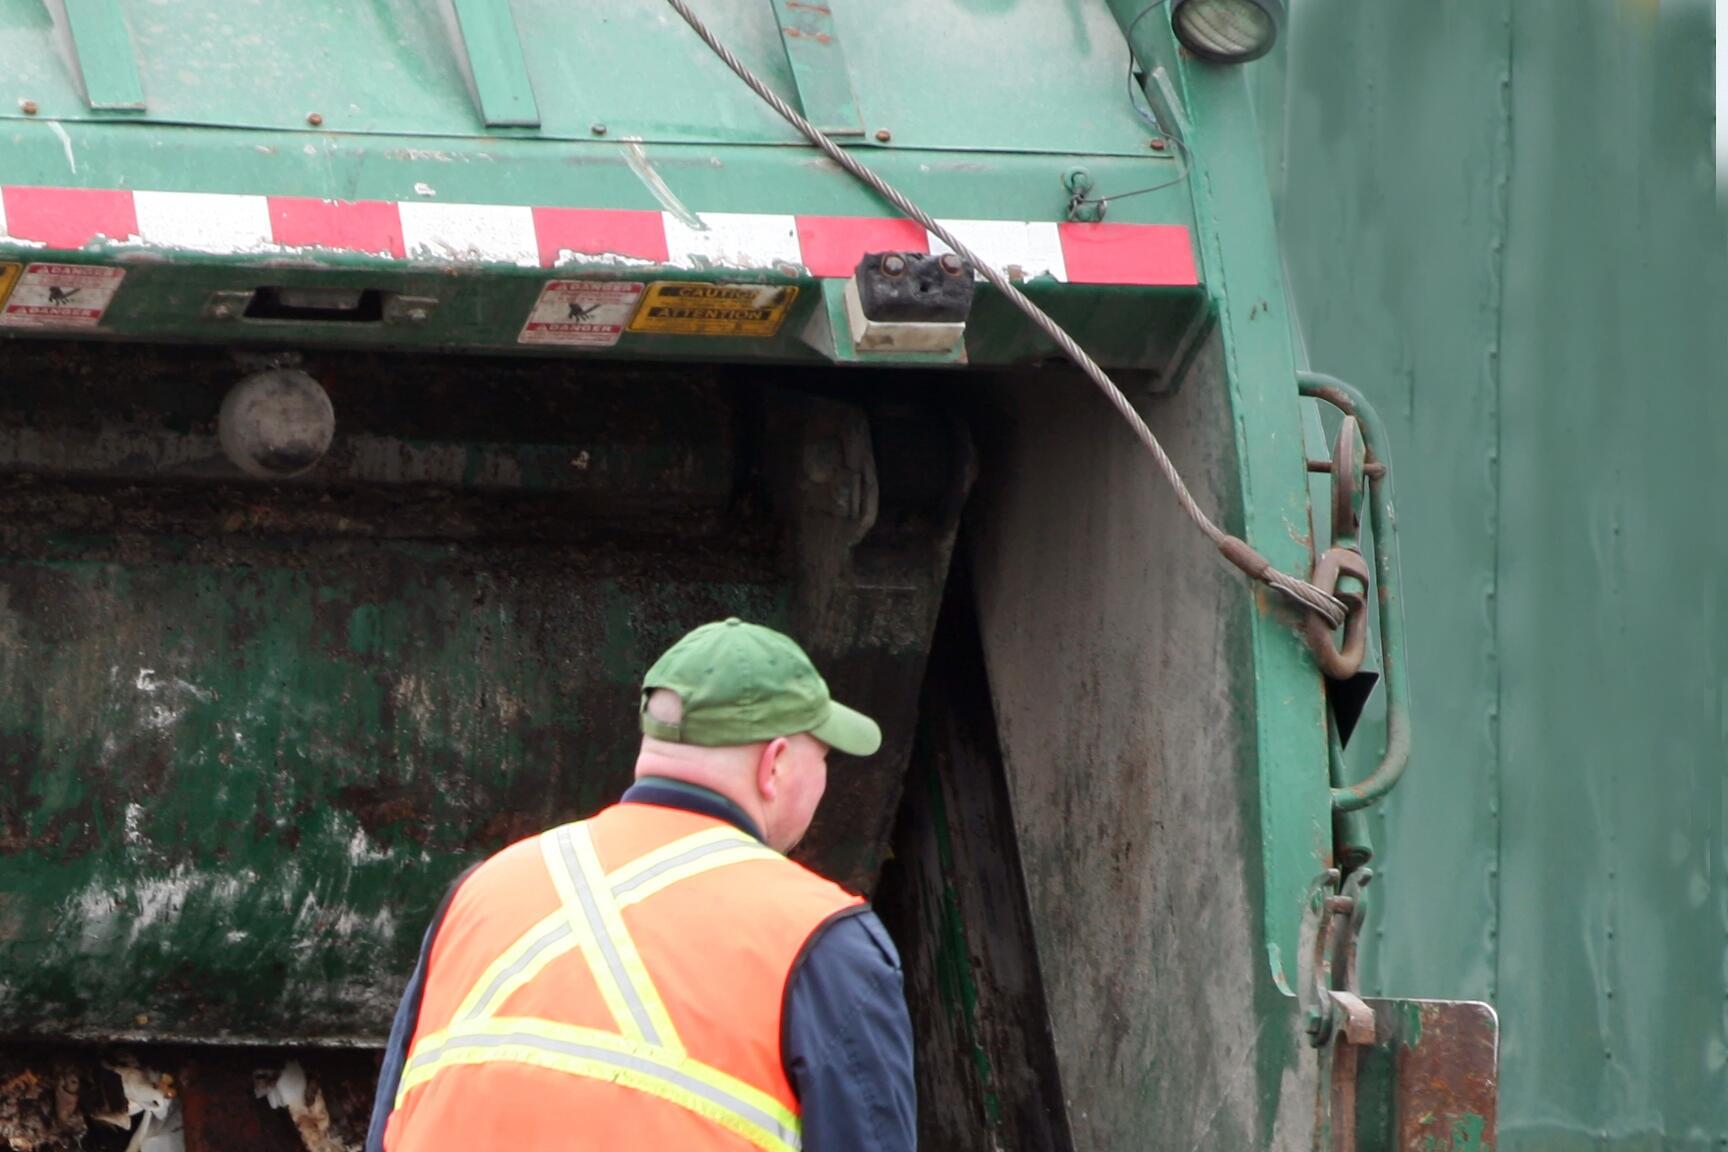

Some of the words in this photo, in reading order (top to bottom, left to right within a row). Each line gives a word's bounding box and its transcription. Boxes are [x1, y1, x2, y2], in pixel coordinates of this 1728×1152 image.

[568, 282, 633, 292] DANGER
[28, 306, 92, 317] DANGER
[659, 307, 762, 320] ATTENTION
[548, 323, 612, 332] DANGER
